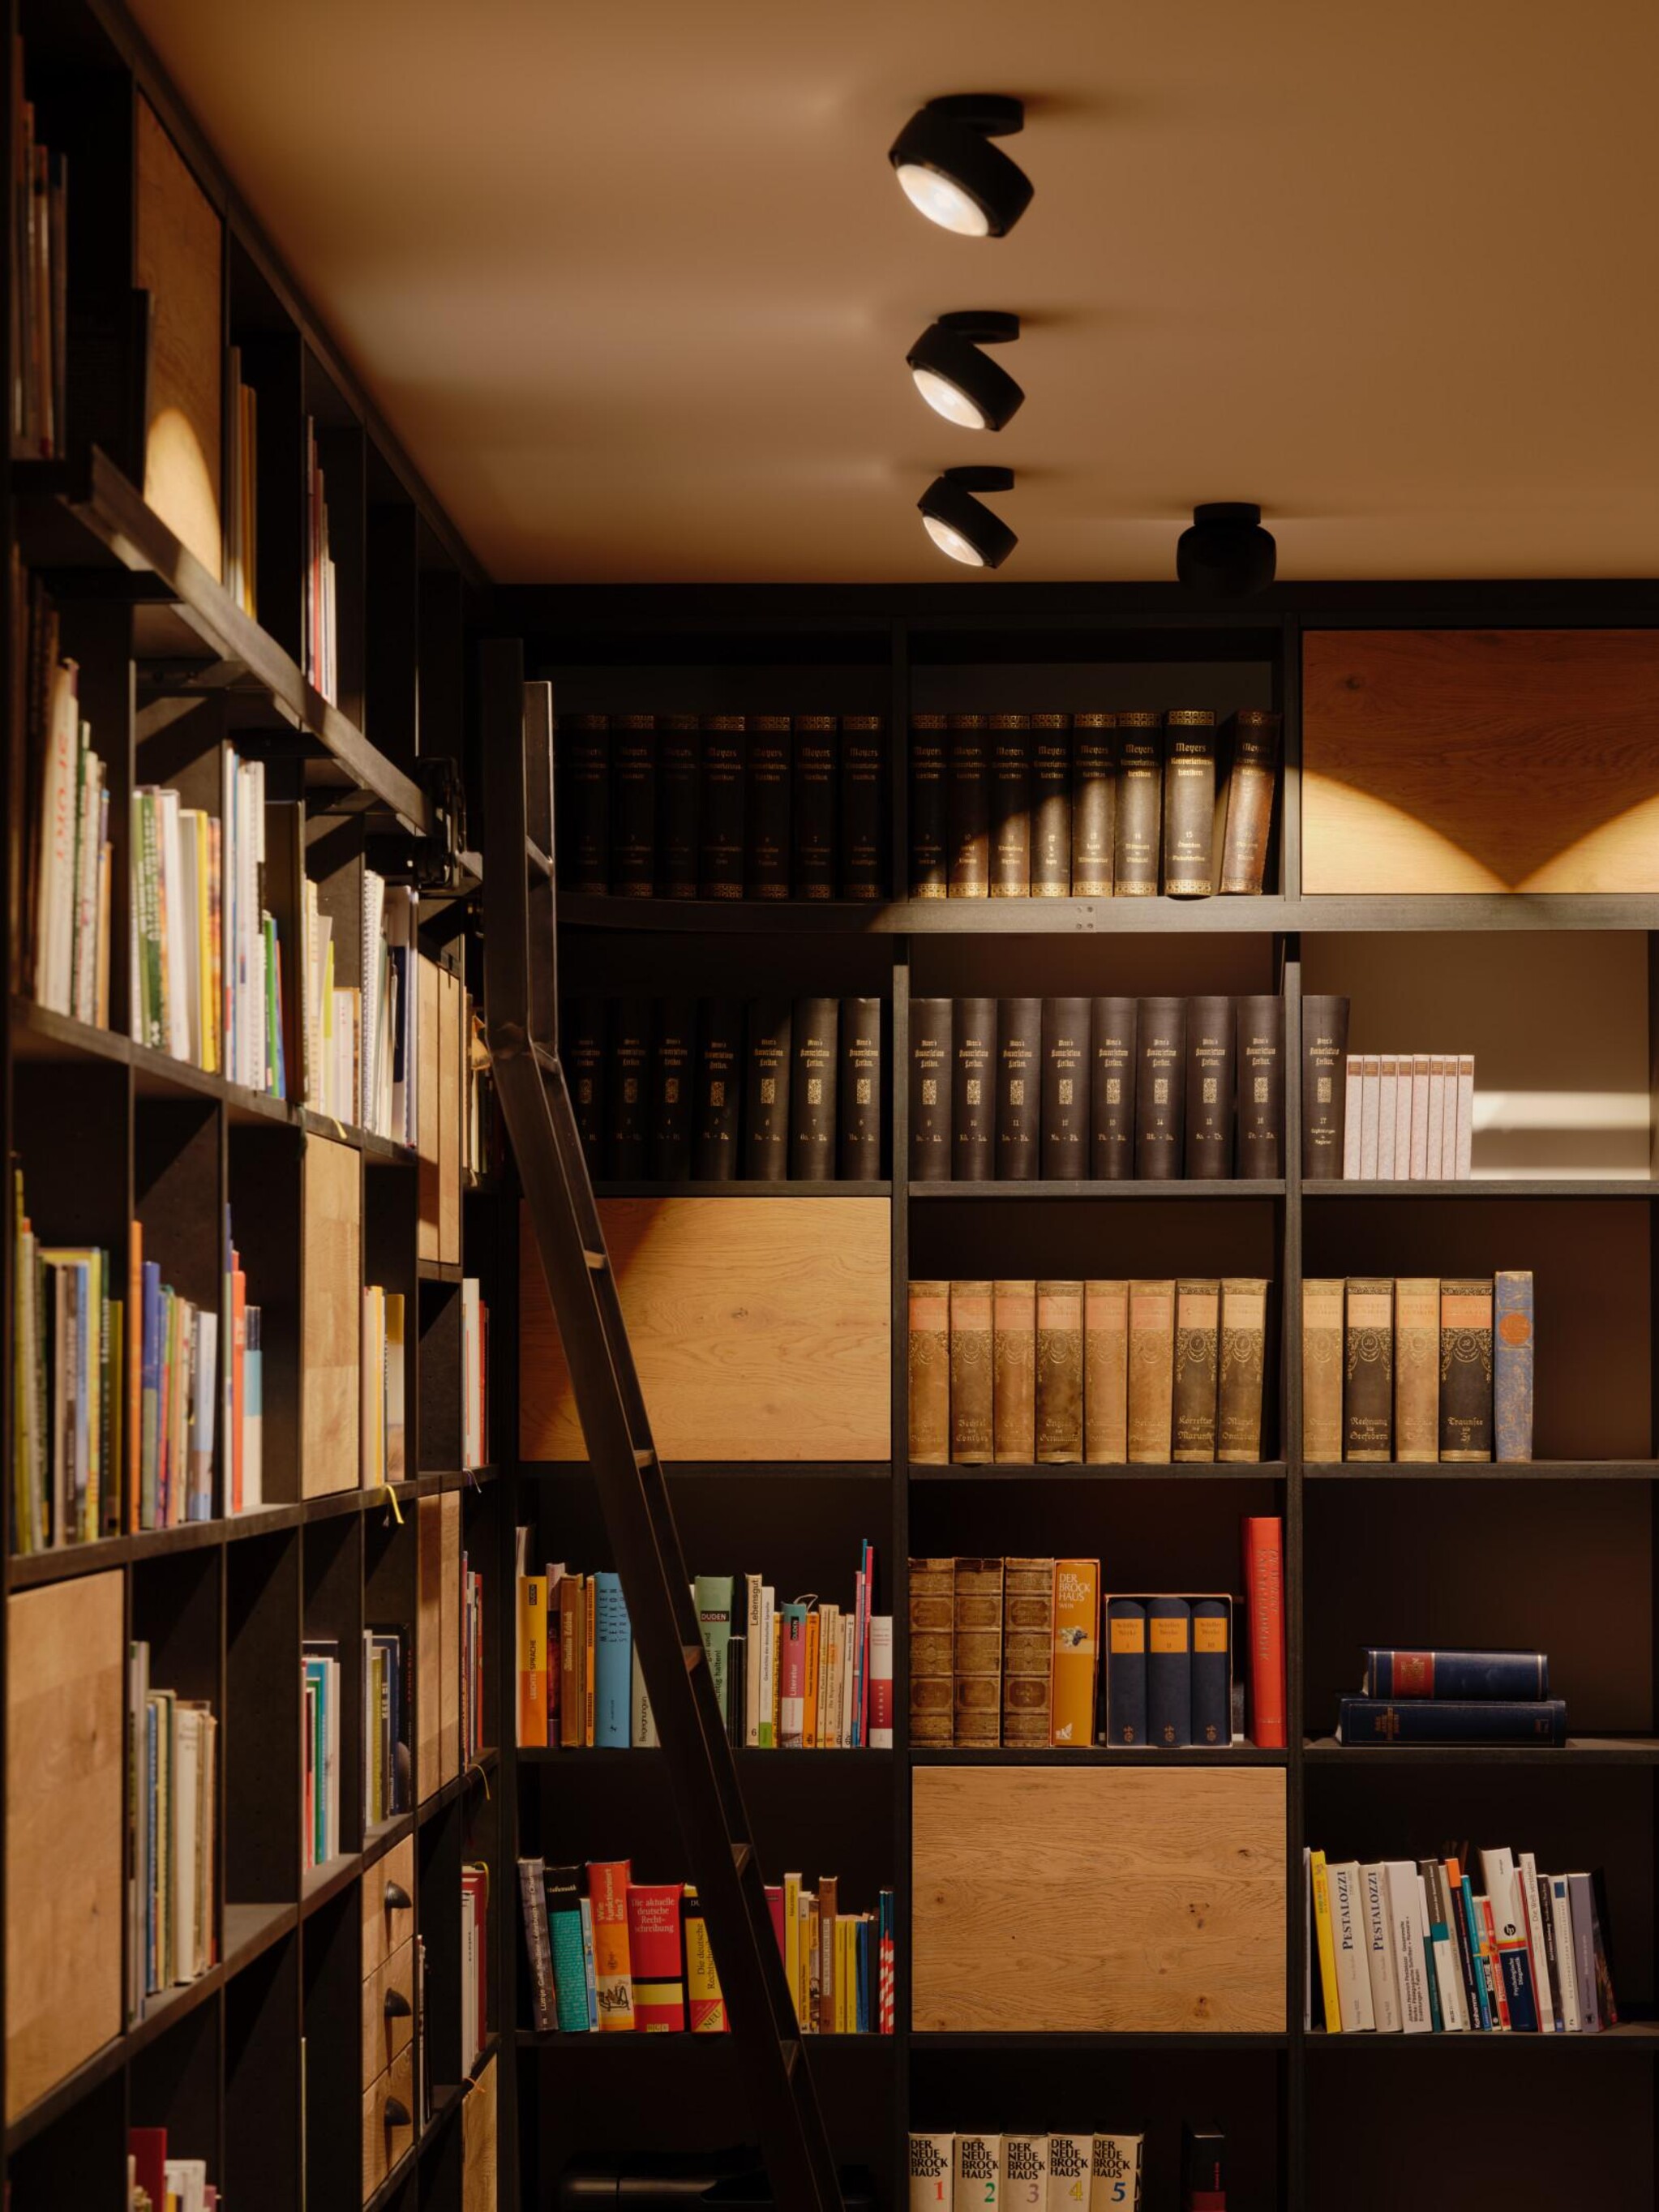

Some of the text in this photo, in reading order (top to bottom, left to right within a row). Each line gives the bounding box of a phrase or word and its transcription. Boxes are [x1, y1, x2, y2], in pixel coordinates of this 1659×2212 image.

[1125, 744, 1155, 755] Meyers
[1176, 743, 1207, 753] Meyers
[1059, 1573, 1078, 1583] DER
[1058, 1583, 1091, 1593] BROCK
[1058, 1592, 1085, 1601] HAUS
[751, 1579, 761, 1626] Lebensgut
[609, 1588, 617, 1642] LEXIKON
[530, 1640, 538, 1700] LEICHTE SPRACHE
[791, 1665, 799, 1696] Literatur
[639, 1696, 648, 1742] Begegnungen
[751, 1729, 757, 1737] 6
[805, 1734, 813, 1744] dtv
[1526, 1862, 1534, 1893] verstehen
[605, 1868, 614, 1922] funktioniert
[645, 1898, 675, 1906] aktuelle
[615, 1899, 624, 1920] das?
[637, 1907, 670, 1915] deutsche
[1339, 1871, 1353, 1950] PESTALOZZI
[1370, 1871, 1384, 1950] PESTALOZZI
[641, 1916, 665, 1925] Recht-
[635, 1925, 675, 1934] schreibung
[697, 1923, 705, 1957] deutsche
[1508, 1957, 1520, 1996] Psychologische
[1515, 1957, 1523, 1986] Diagnostik
[1471, 1991, 1481, 2029] Kohlhammer
[704, 2009, 722, 2030] NEU
[911, 2140, 932, 2150] DER
[962, 2141, 985, 2151] DER
[1008, 2142, 1031, 2152] DER
[1051, 2139, 1074, 2149] DER
[1094, 2141, 1116, 2150] DER
[911, 2150, 940, 2158] NEUE
[962, 2151, 992, 2161] NEUE
[1008, 2152, 1039, 2162] NEUE
[1051, 2149, 1081, 2158] NEUE
[1094, 2150, 1123, 2160] NEUE
[911, 2158, 948, 2167] BROCK
[962, 2161, 999, 2170] BROCK
[1008, 2162, 1046, 2171] BROCK
[1050, 2158, 1088, 2167] BROCK
[1093, 2160, 1130, 2169] BROCK
[911, 2167, 941, 2177] HAUS
[962, 2170, 992, 2180] HAUS
[1008, 2171, 1039, 2180] HAUS
[1050, 2167, 1081, 2177] HAUS
[1093, 2169, 1123, 2179] HAUS
[933, 2181, 944, 2201] 1
[984, 2183, 996, 2202] 2
[1027, 2183, 1039, 2203] 3
[1069, 2180, 1083, 2201] 4
[1111, 2182, 1126, 2202] 5
